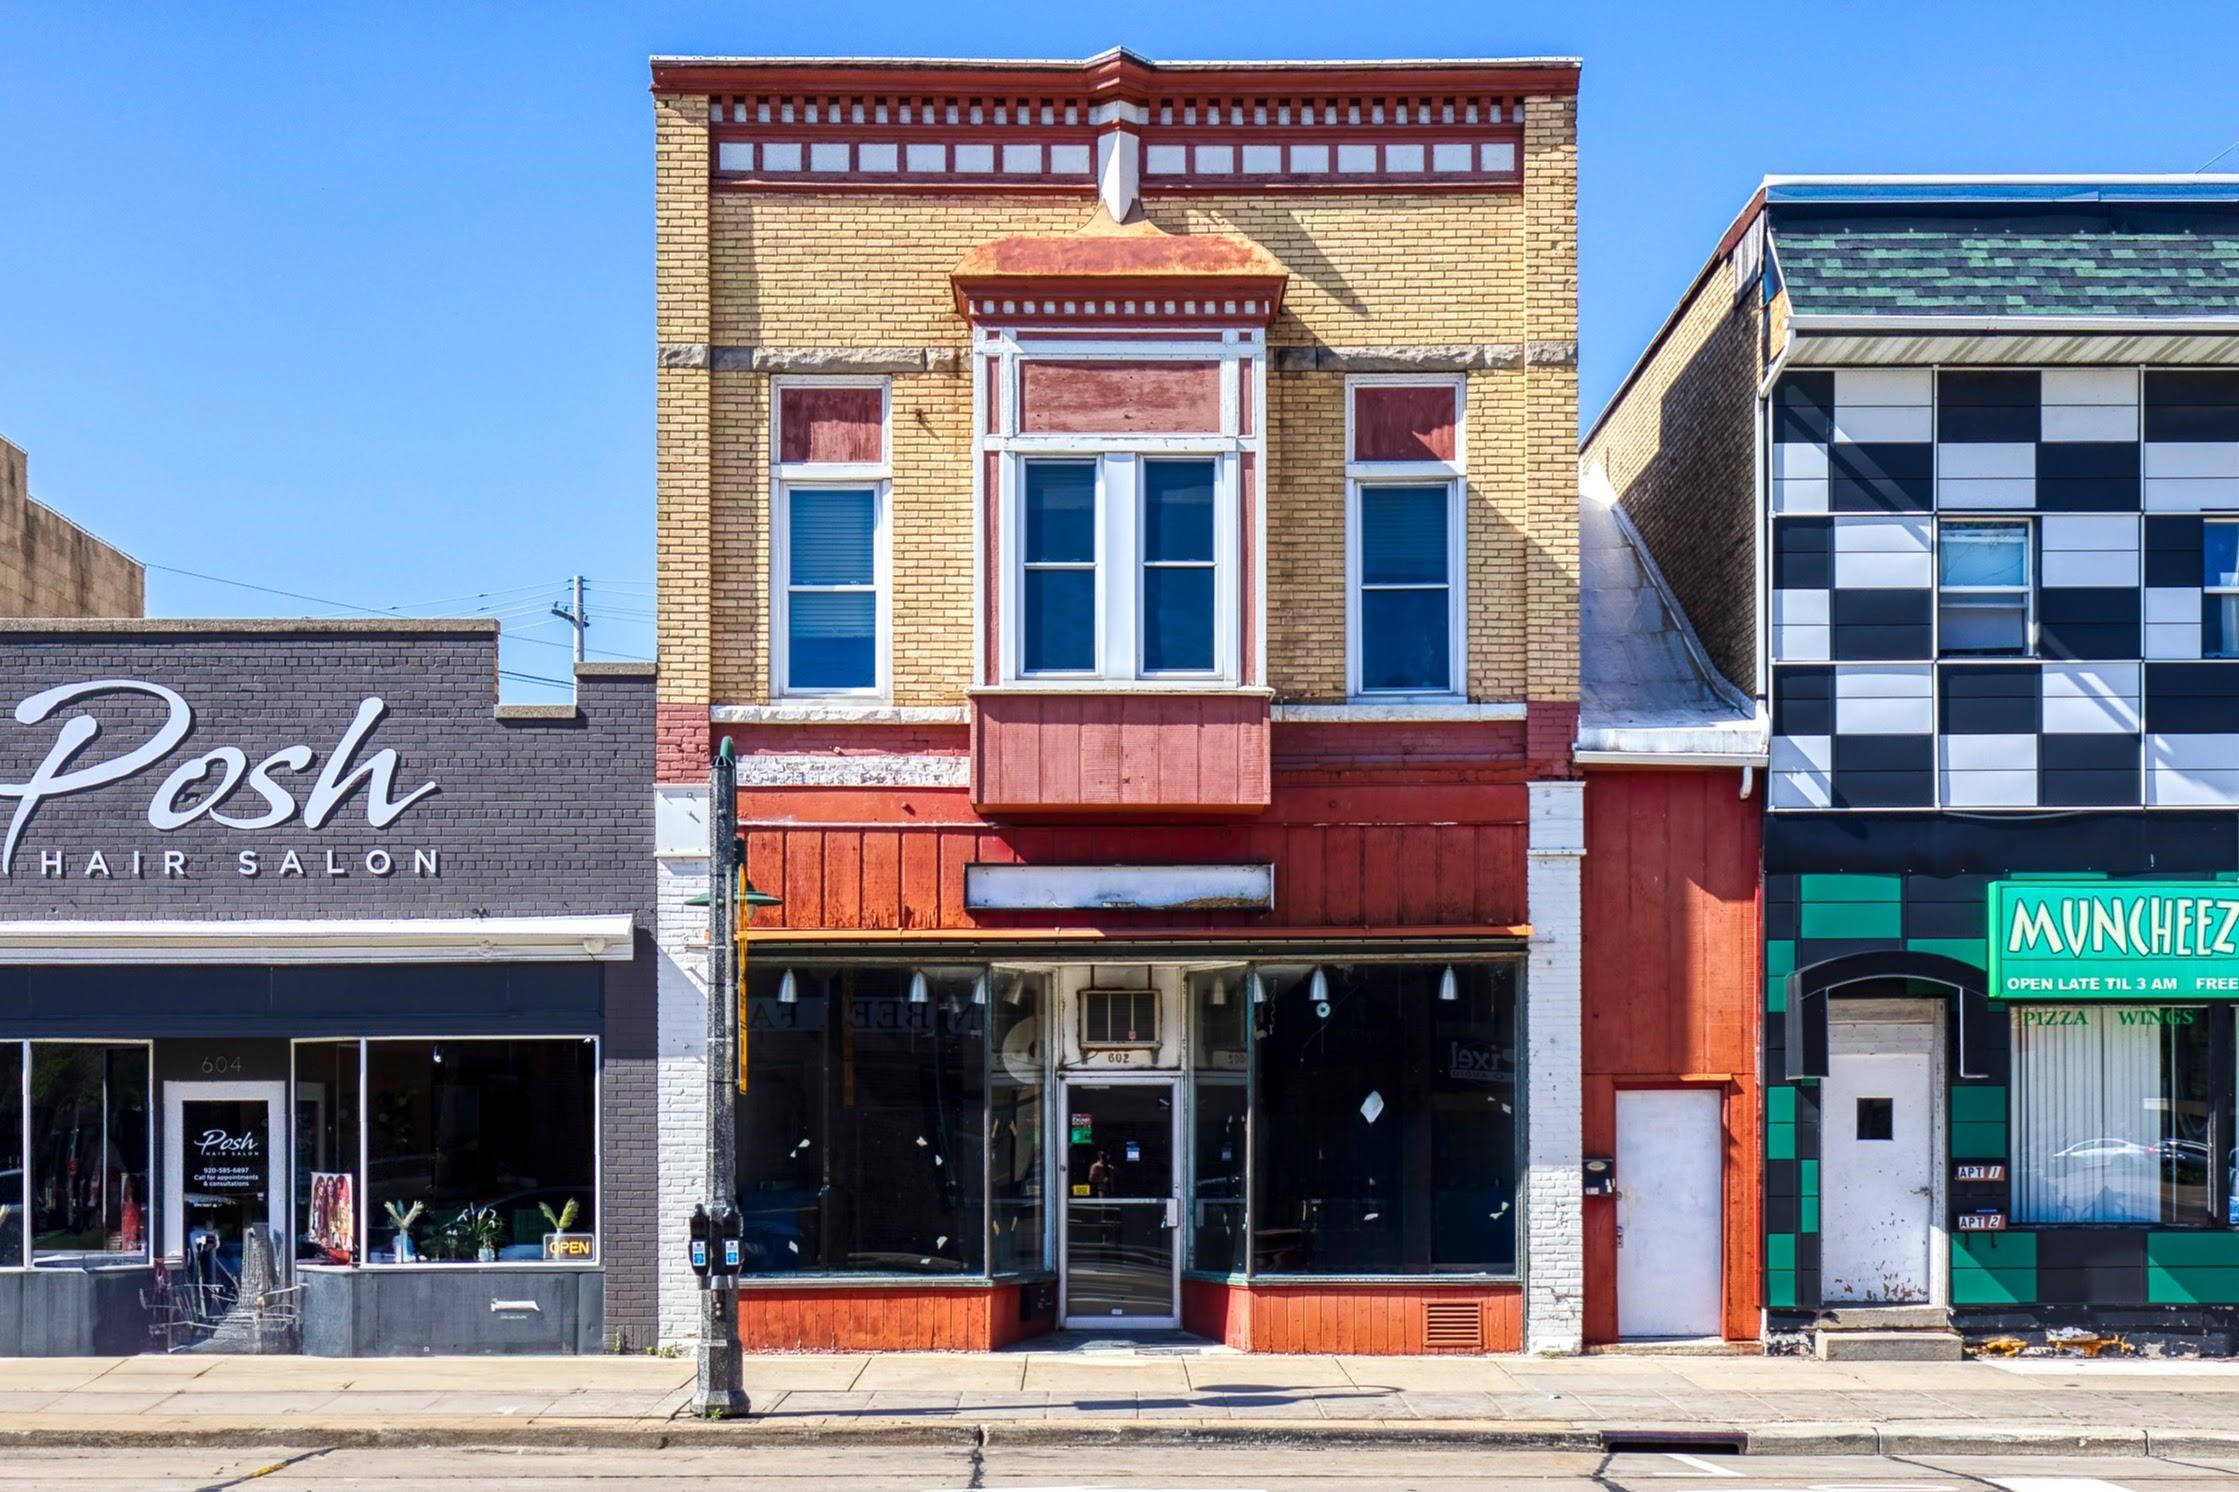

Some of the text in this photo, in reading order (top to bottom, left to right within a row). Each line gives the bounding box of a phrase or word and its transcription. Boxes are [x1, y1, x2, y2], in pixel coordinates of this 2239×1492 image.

[0, 680, 436, 875] Posh
[41, 849, 438, 876] HAIR SALON
[2008, 897, 2238, 957] MUNCHEEZ
[2007, 977, 2238, 990] OPEN LATE TIL 3 AM FREE
[2023, 1010, 2194, 1026] PIZZA WINGS
[200, 1055, 242, 1074] 604
[1108, 1053, 1130, 1064] 602
[193, 1129, 258, 1156] Posh
[217, 1174, 259, 1182] appointments
[1959, 1167, 1997, 1178] APT 1
[1960, 1216, 1999, 1227] APT 2
[549, 1241, 590, 1254] OPEN
